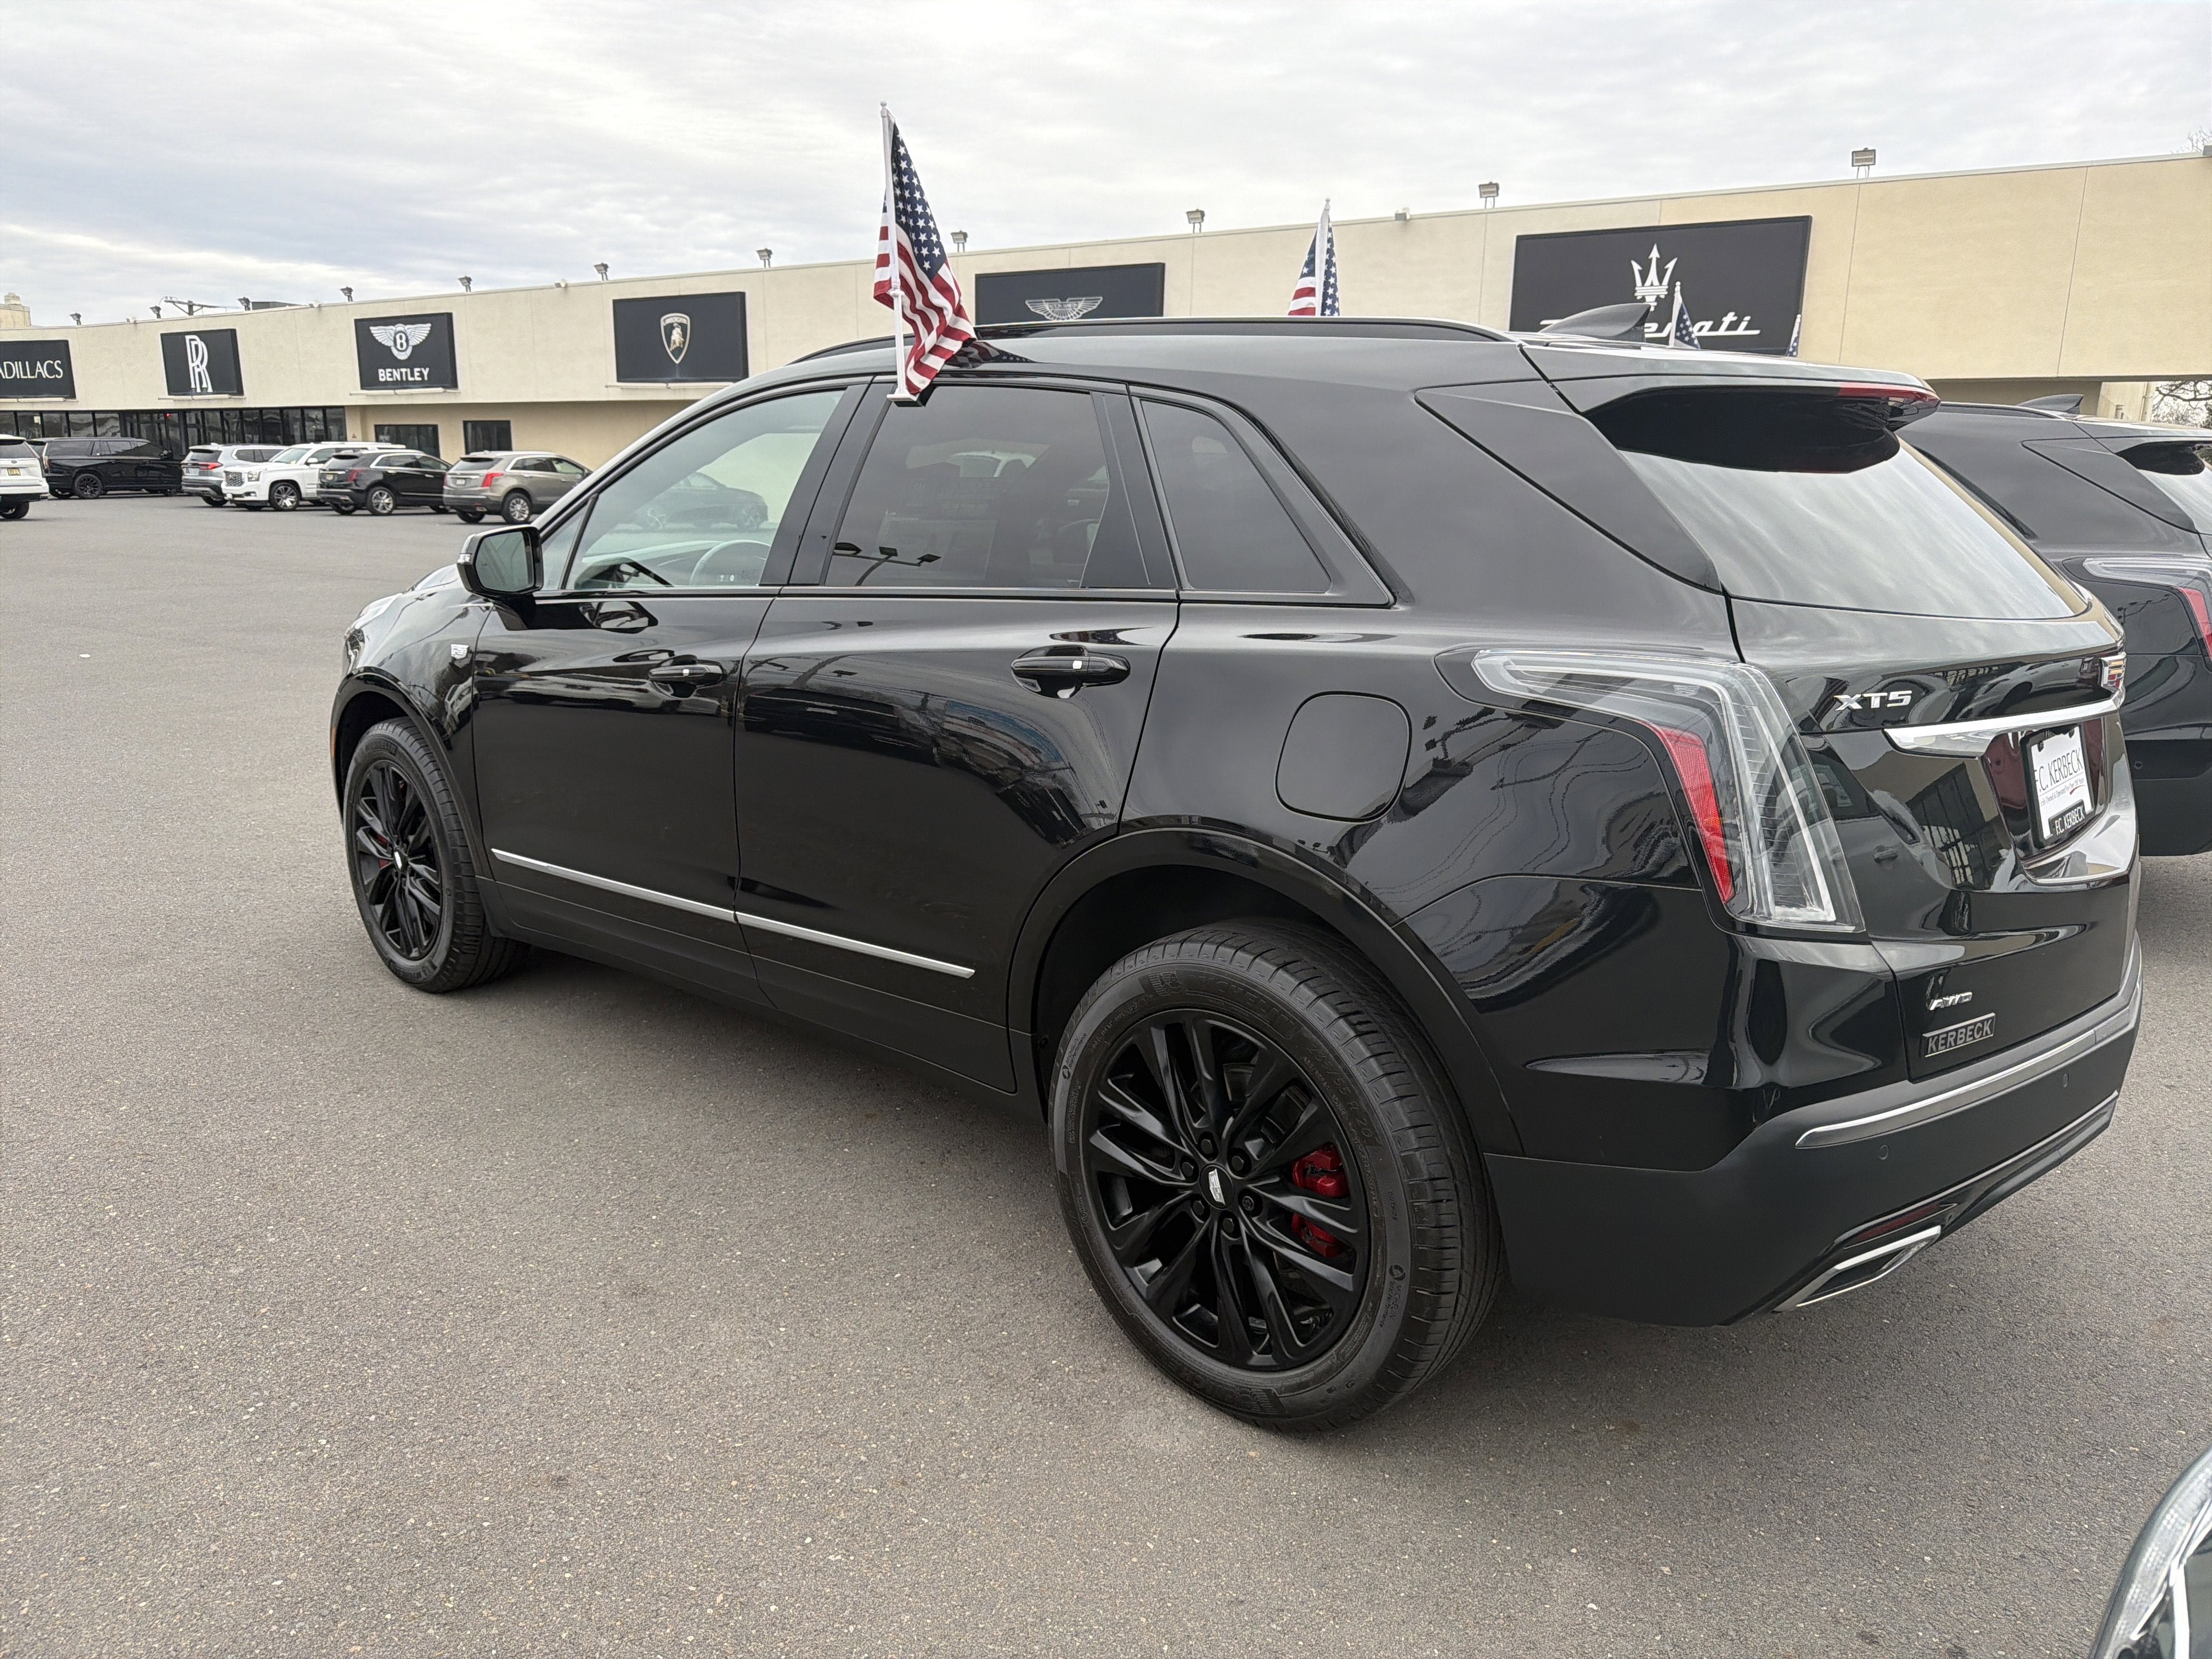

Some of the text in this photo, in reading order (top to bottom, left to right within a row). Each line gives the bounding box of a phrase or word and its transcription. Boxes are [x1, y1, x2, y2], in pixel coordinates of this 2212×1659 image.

[377, 367, 430, 382] BENTLEY
[1833, 690, 1912, 712] XT5
[2047, 747, 2084, 786] KERBECK
[2063, 804, 2085, 831] KERBECK
[1927, 1019, 1993, 1054] KERBECK
